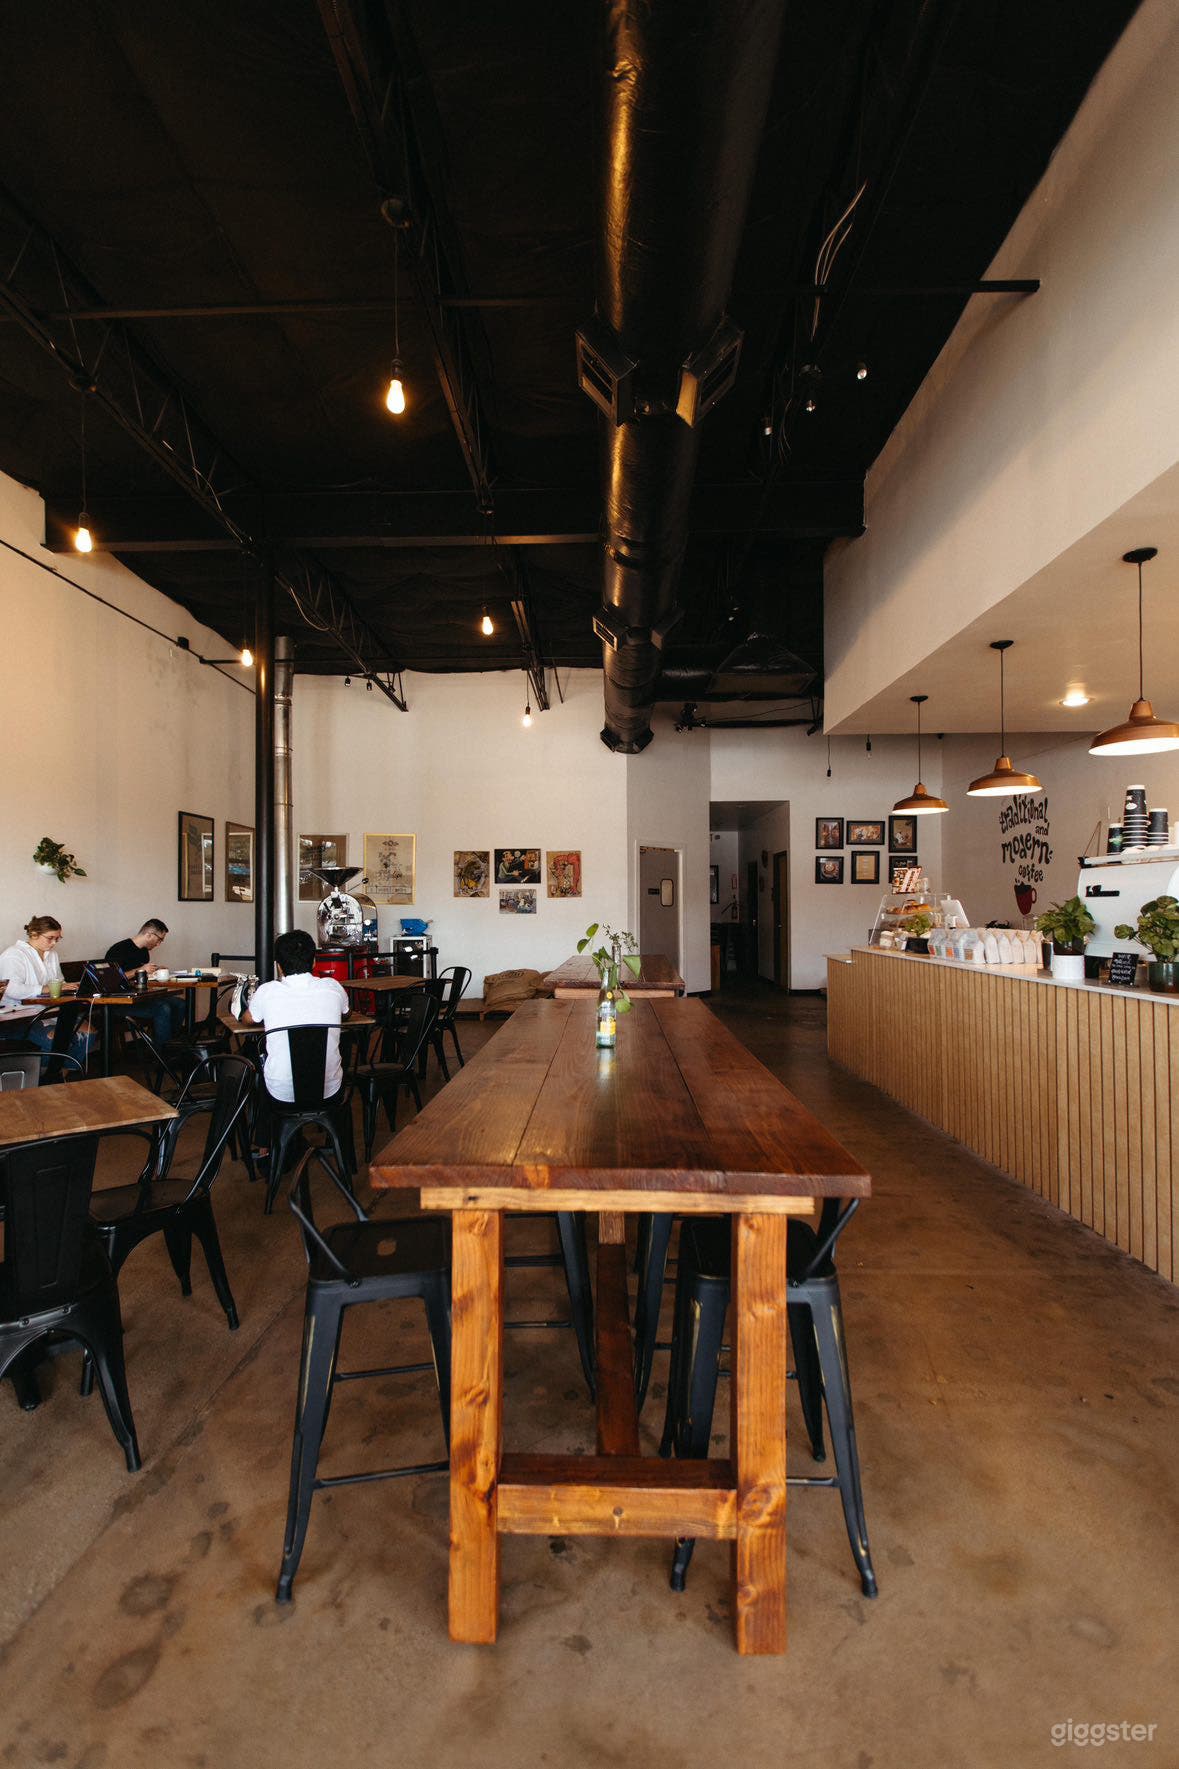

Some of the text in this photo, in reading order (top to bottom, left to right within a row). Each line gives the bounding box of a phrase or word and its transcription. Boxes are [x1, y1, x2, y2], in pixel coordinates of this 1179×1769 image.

[1000, 794, 1048, 834] traditional
[1035, 822, 1050, 836] and
[1001, 832, 1050, 865] modern
[1018, 863, 1044, 883] coffee
